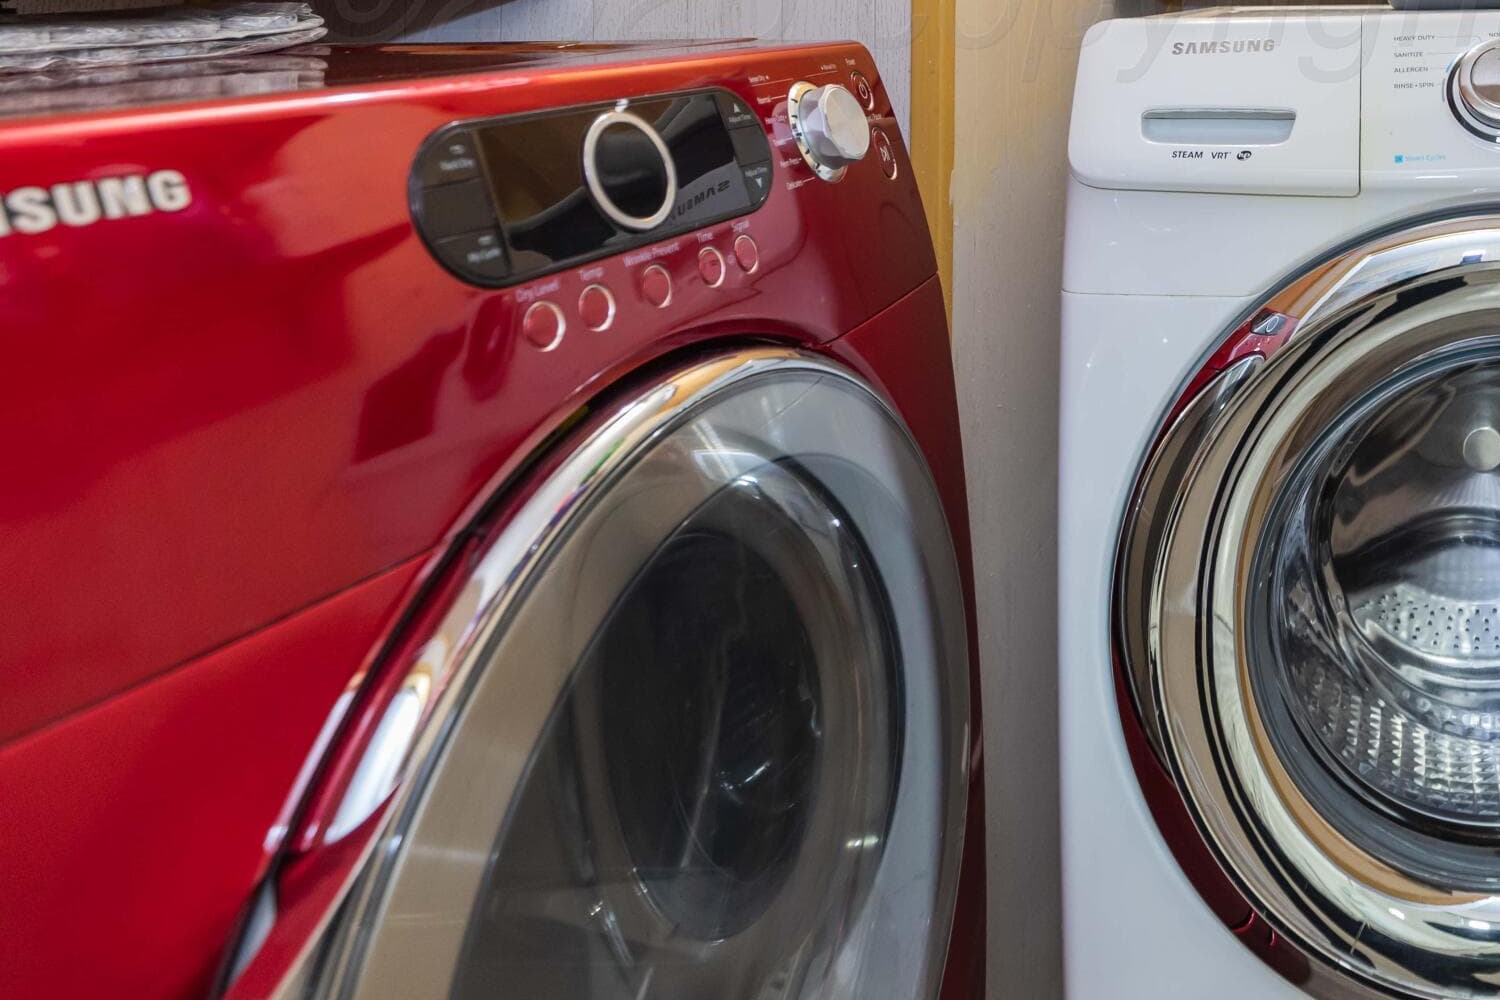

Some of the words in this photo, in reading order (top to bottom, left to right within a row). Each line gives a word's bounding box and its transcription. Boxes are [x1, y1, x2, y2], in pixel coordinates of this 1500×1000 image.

[1172, 39, 1275, 55] SAMSUNG
[1172, 150, 1204, 159] STEAM
[696, 231, 714, 242] Time
